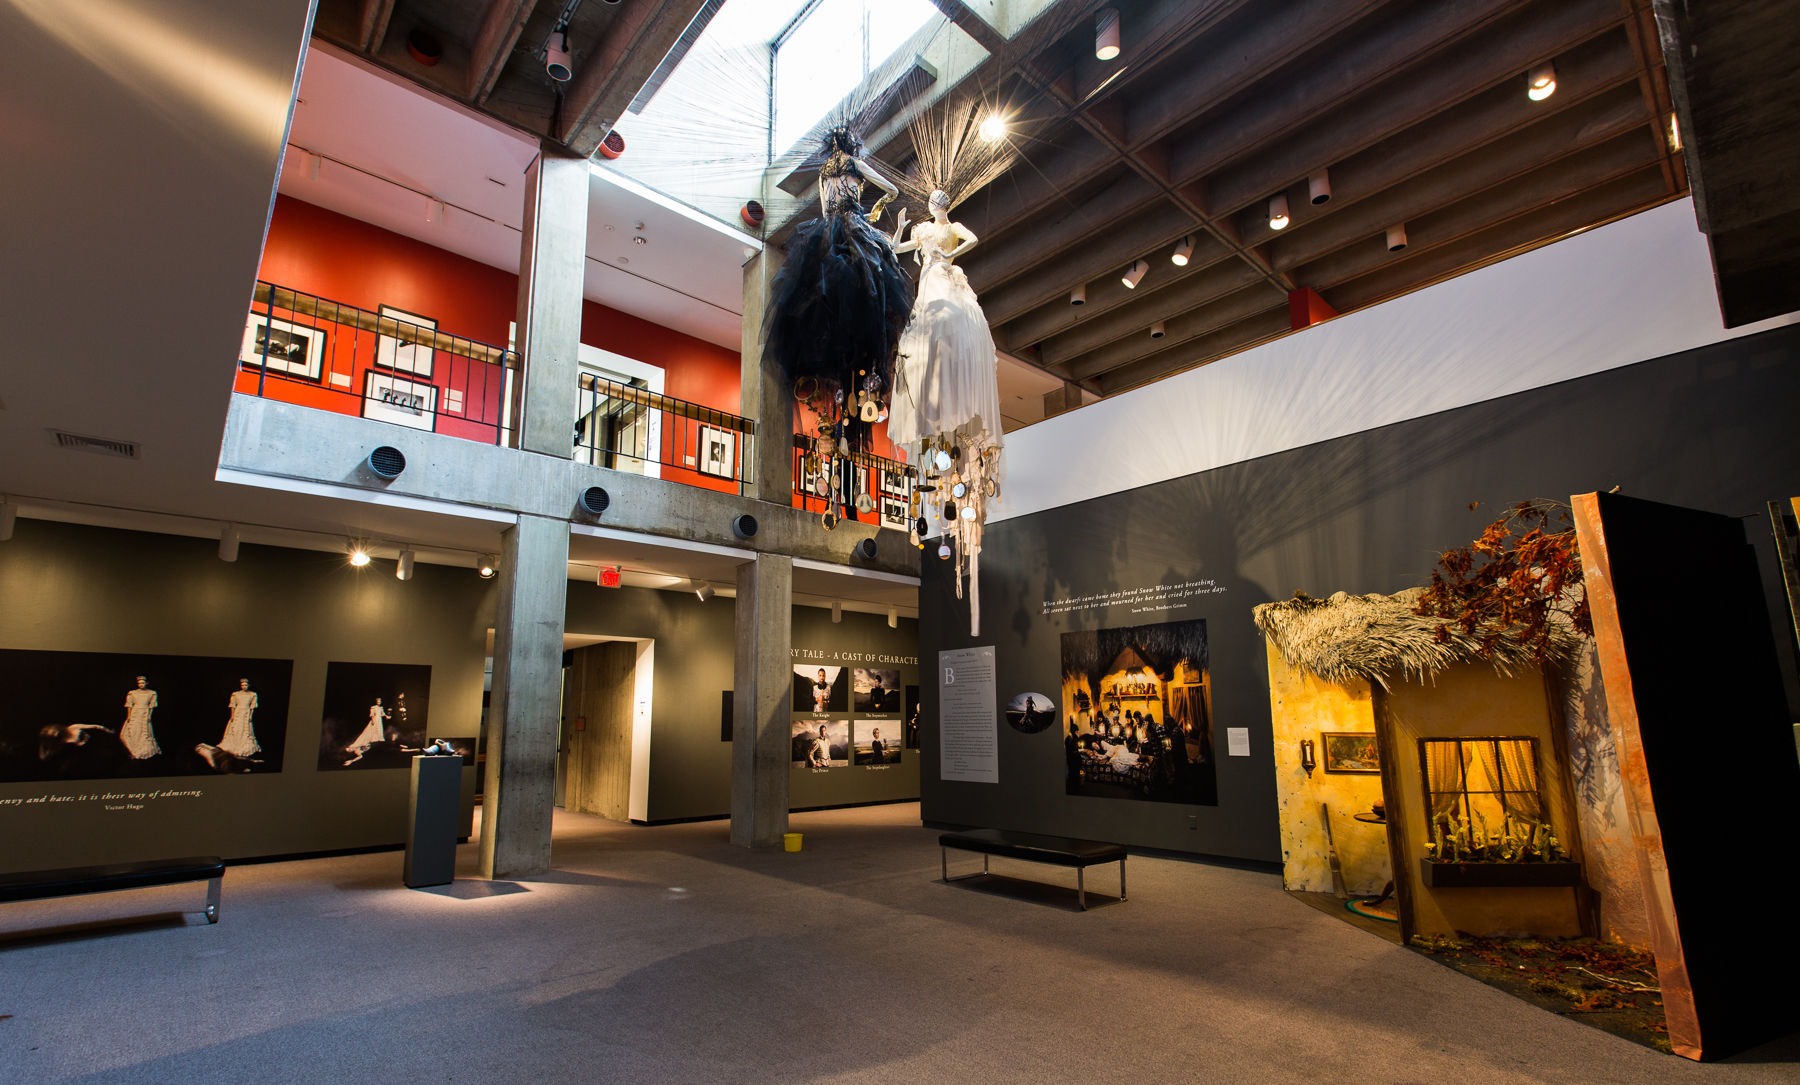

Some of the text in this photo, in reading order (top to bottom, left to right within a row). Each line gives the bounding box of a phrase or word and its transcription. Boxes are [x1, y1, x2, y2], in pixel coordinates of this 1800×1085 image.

[602, 572, 620, 587] EXIT
[1111, 597, 1134, 605] mourned
[1135, 596, 1143, 604] for
[1184, 590, 1193, 598] for
[1212, 586, 1227, 594] days.
[1122, 588, 1137, 598] found
[1185, 579, 1216, 588] breathing.
[803, 650, 824, 659] TALE
[834, 652, 839, 660] A
[842, 652, 862, 660] CAST
[865, 654, 876, 662] OF
[879, 655, 918, 664] CHARACTE
[26, 795, 47, 803] and
[148, 789, 160, 799] of
